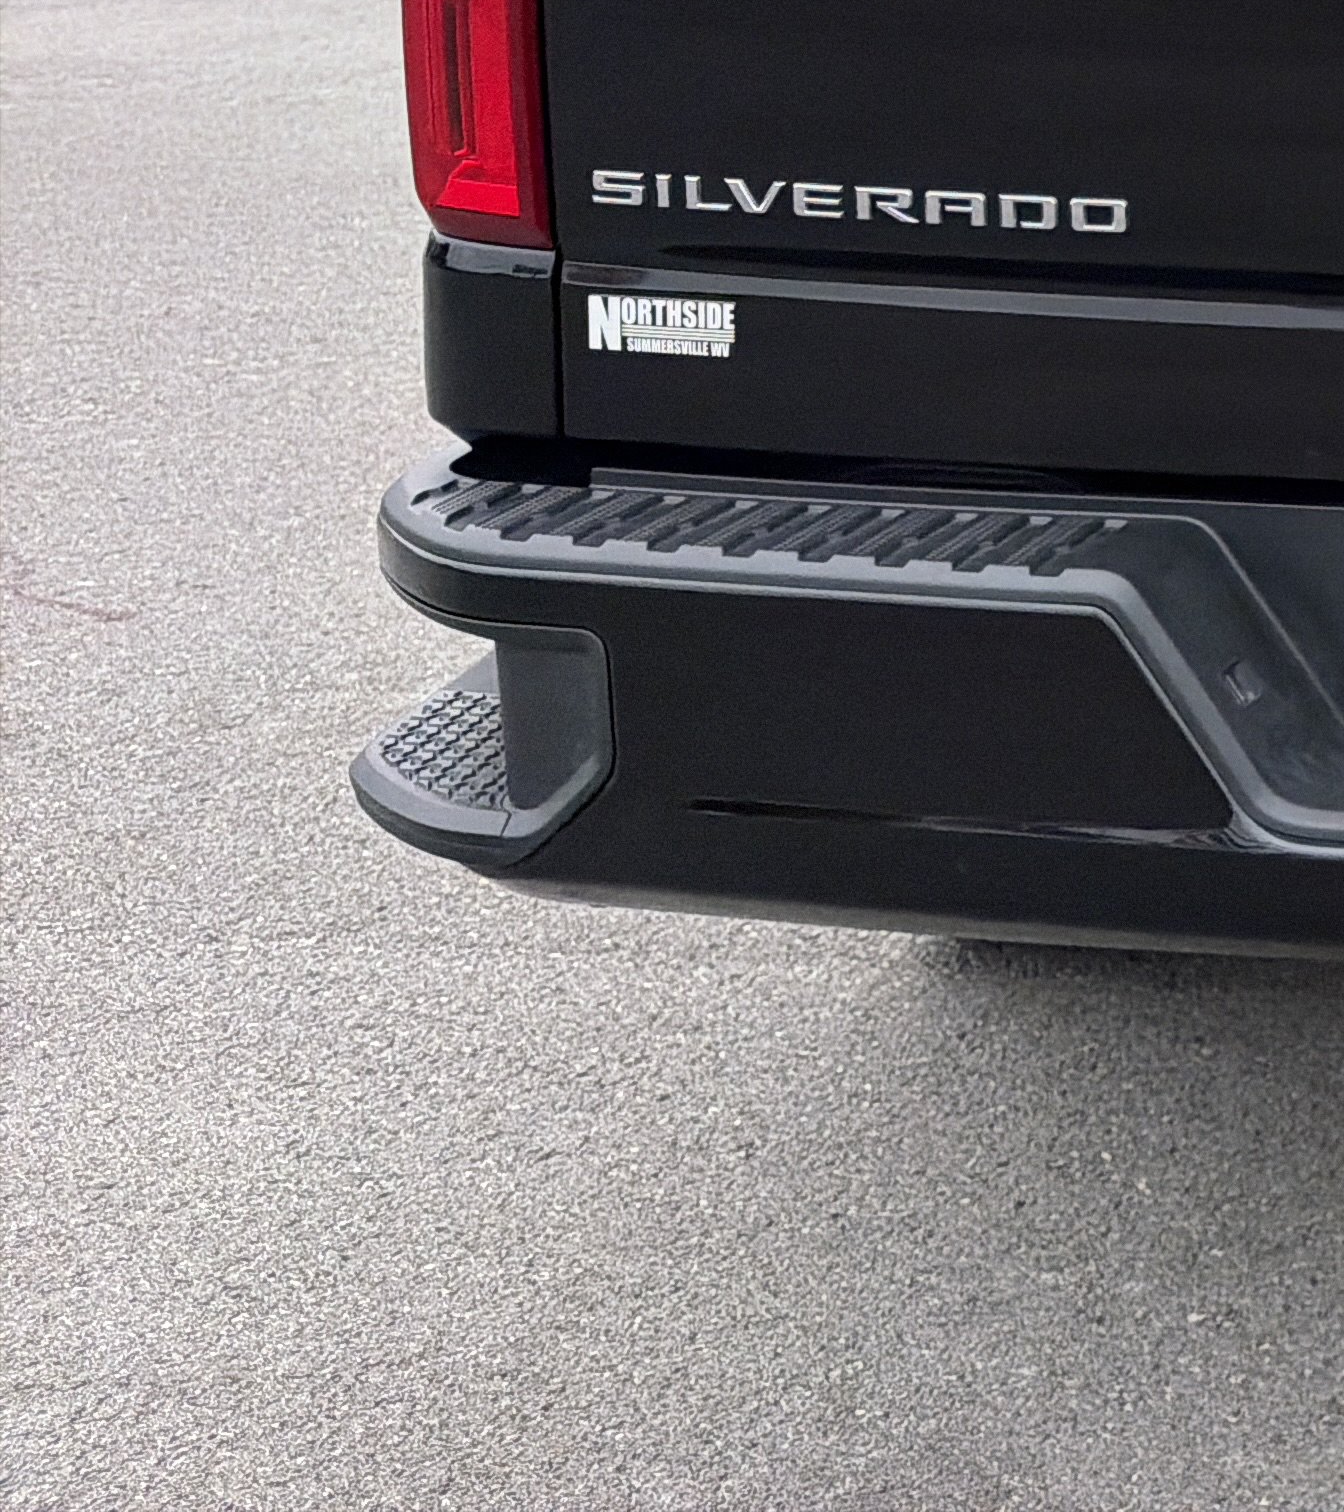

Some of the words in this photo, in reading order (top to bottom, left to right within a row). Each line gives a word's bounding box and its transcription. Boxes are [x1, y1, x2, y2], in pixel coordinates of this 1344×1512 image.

[592, 169, 1129, 233] SILVERADO
[588, 294, 735, 351] NORTHSIDE
[627, 338, 708, 356] SUMMERSVILLE
[711, 342, 730, 358] WV
